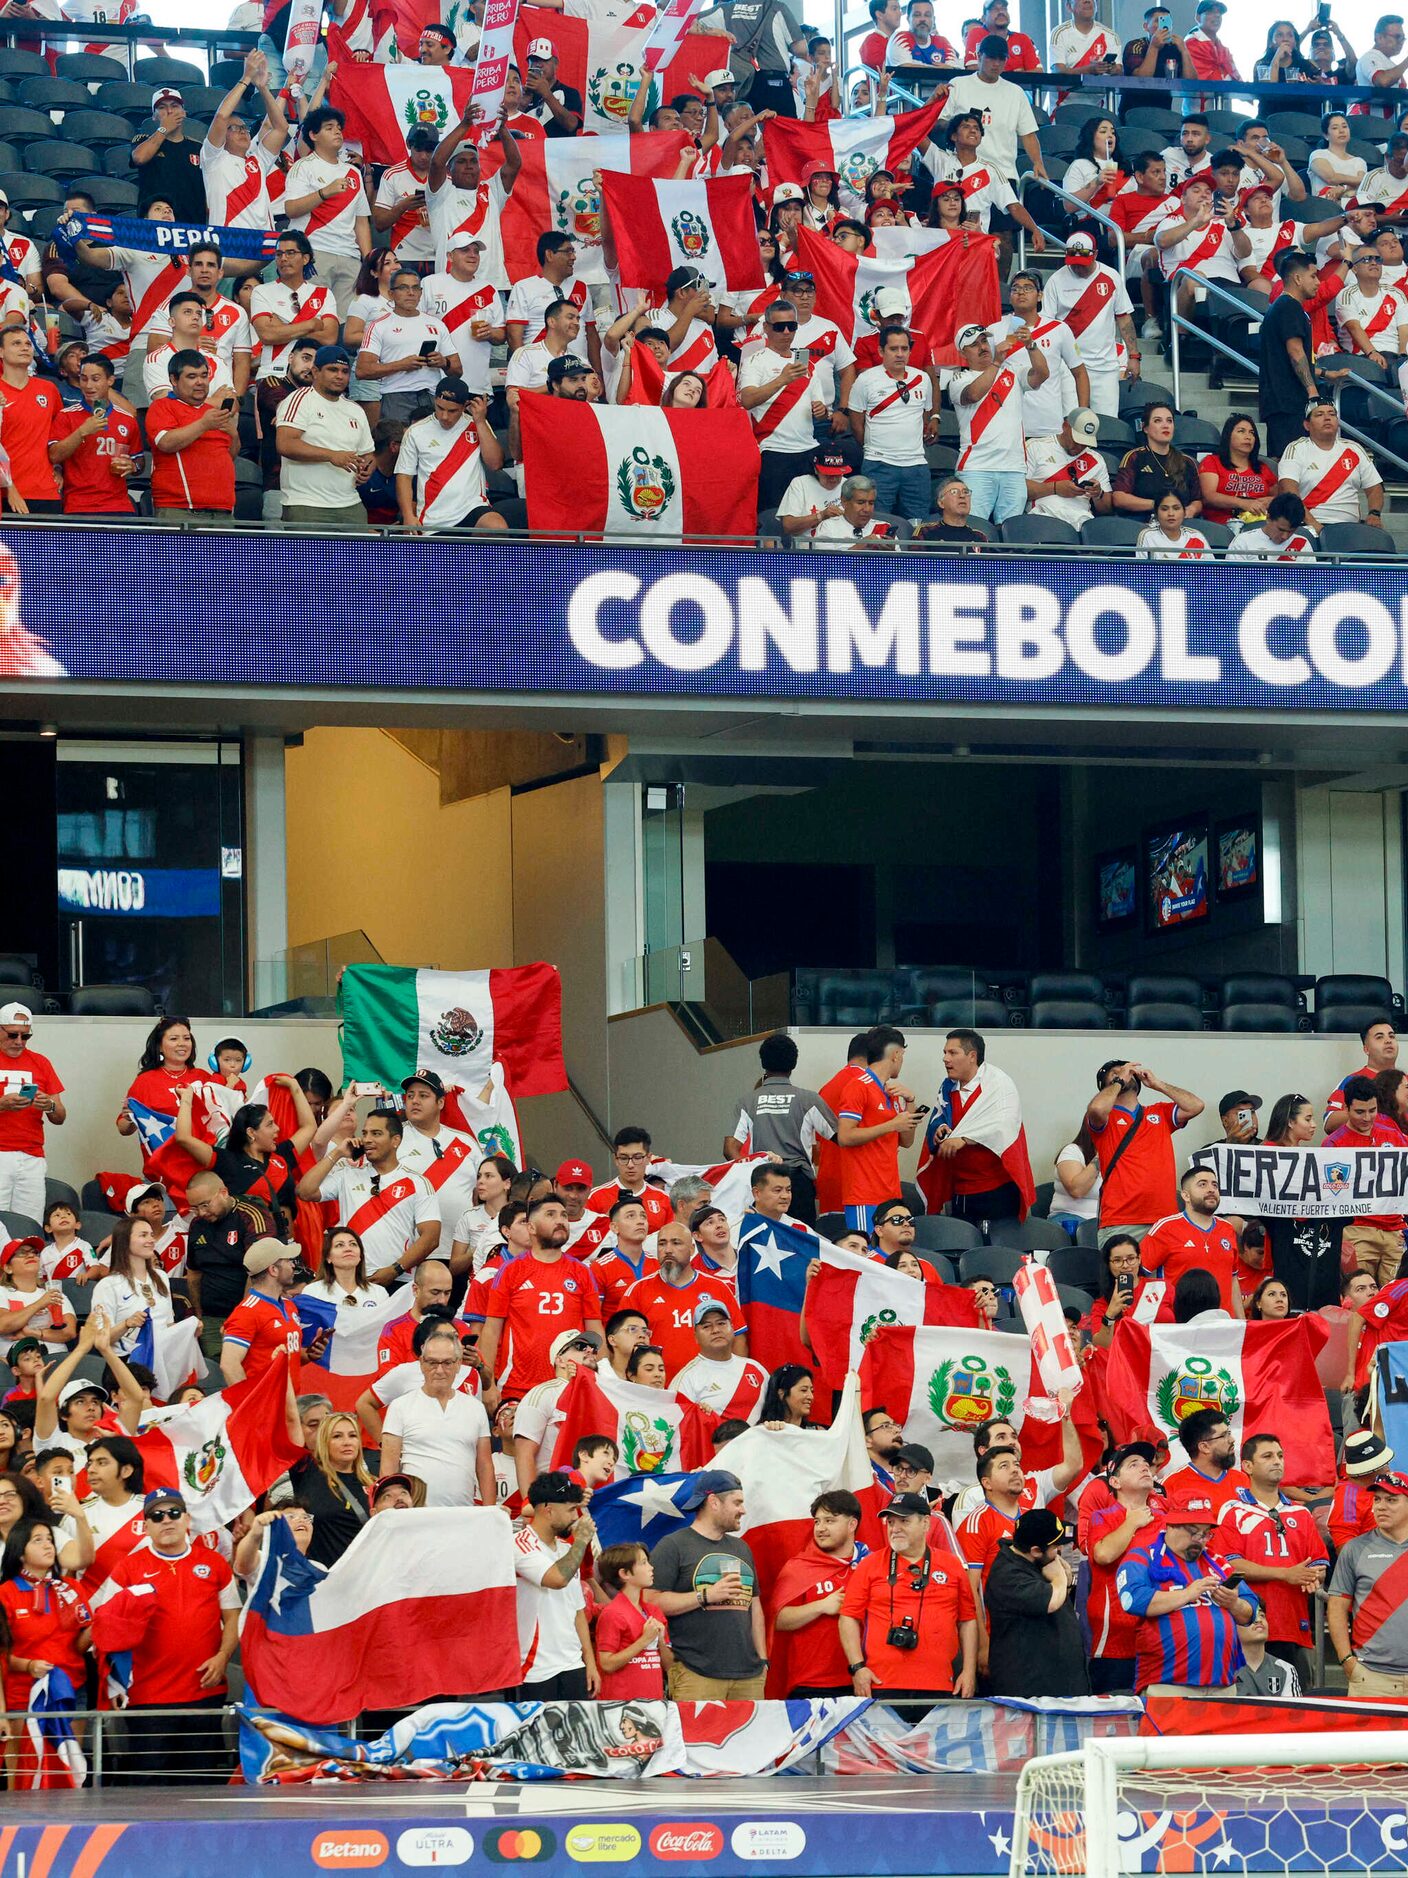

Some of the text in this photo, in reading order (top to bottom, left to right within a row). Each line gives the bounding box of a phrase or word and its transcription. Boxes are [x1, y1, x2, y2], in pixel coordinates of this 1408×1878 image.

[733, 4, 763, 15] BEST
[1170, 173, 1179, 188] 8
[156, 226, 221, 249] PERÚ
[434, 300, 449, 315] 20
[96, 436, 117, 457] 20
[567, 569, 1222, 683] CONMEBOL
[757, 1094, 796, 1105] BEST
[1301, 1204, 1330, 1216] FUERTE
[1333, 1204, 1339, 1215] Y
[1340, 1203, 1373, 1215] GRANDE
[538, 1291, 565, 1315] 23
[673, 1308, 694, 1328] 14
[1264, 1532, 1289, 1557] 11
[816, 1580, 834, 1595] 10
[416, 1839, 455, 1849] ULTRA
[598, 1834, 637, 1843] mercado
[657, 1830, 714, 1852] Coca-Cola
[319, 1841, 382, 1858] Betano
[598, 1842, 617, 1851] libre
